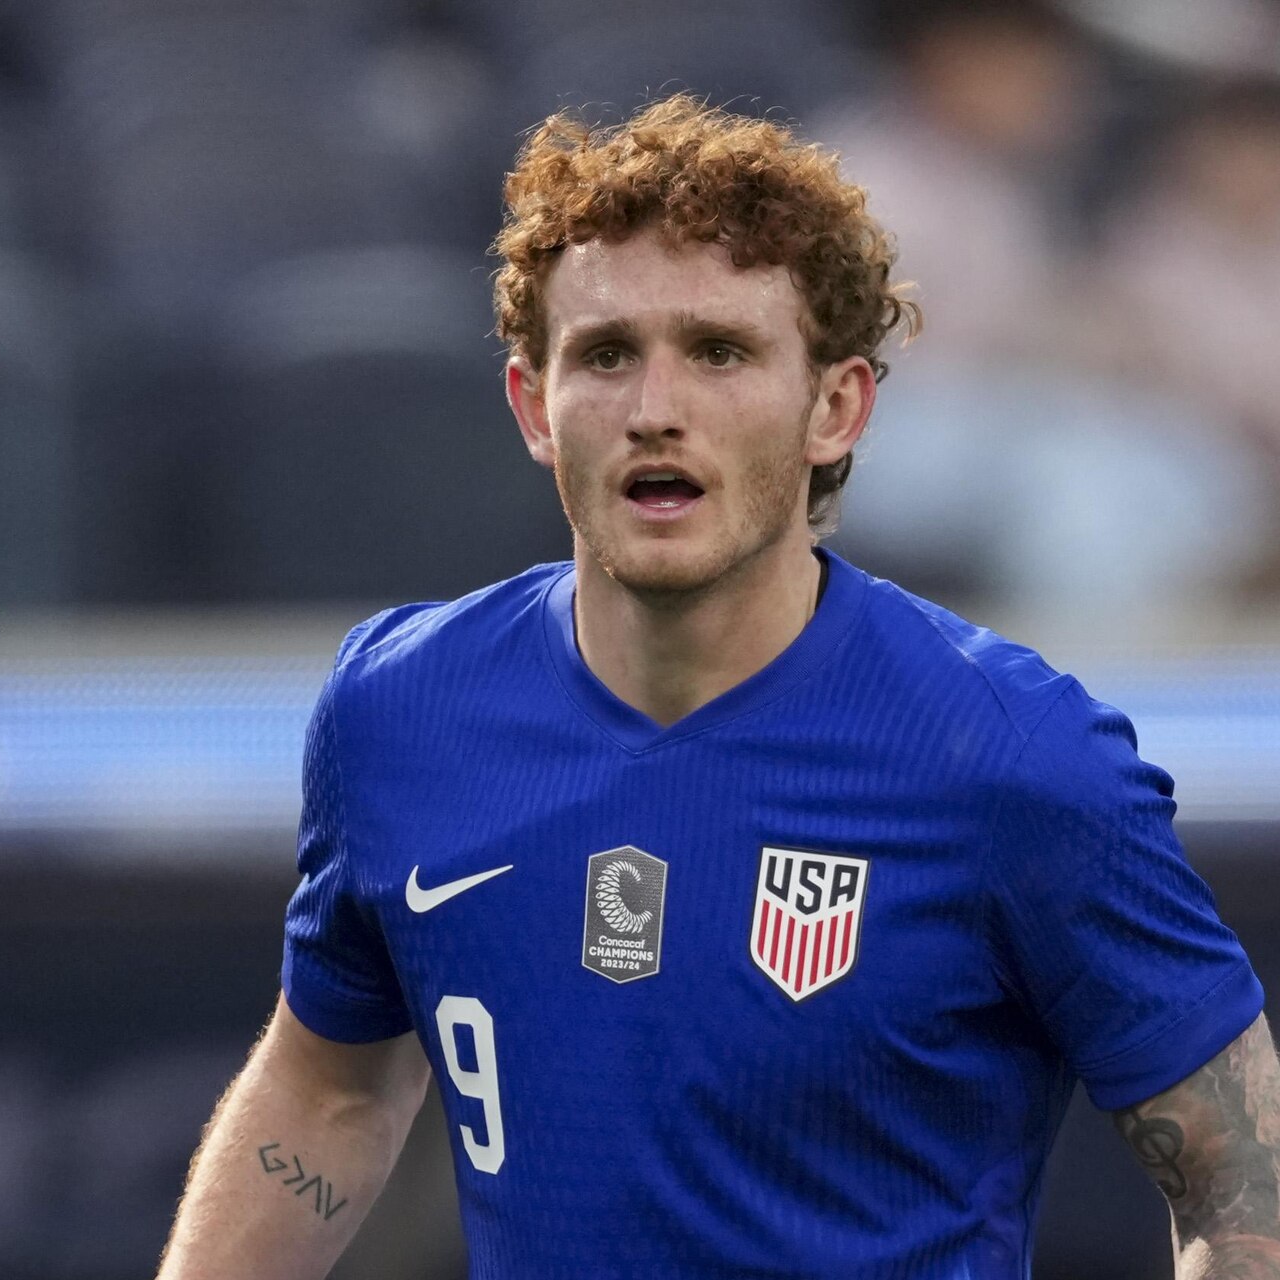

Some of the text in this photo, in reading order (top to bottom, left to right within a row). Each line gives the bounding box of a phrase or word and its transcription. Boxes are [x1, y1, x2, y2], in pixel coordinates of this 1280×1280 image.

[765, 855, 860, 915] USA
[598, 935, 645, 949] Concacaf
[588, 946, 654, 962] CHAMPIONS
[600, 959, 640, 970] 2023/24
[435, 995, 505, 1175] 9
